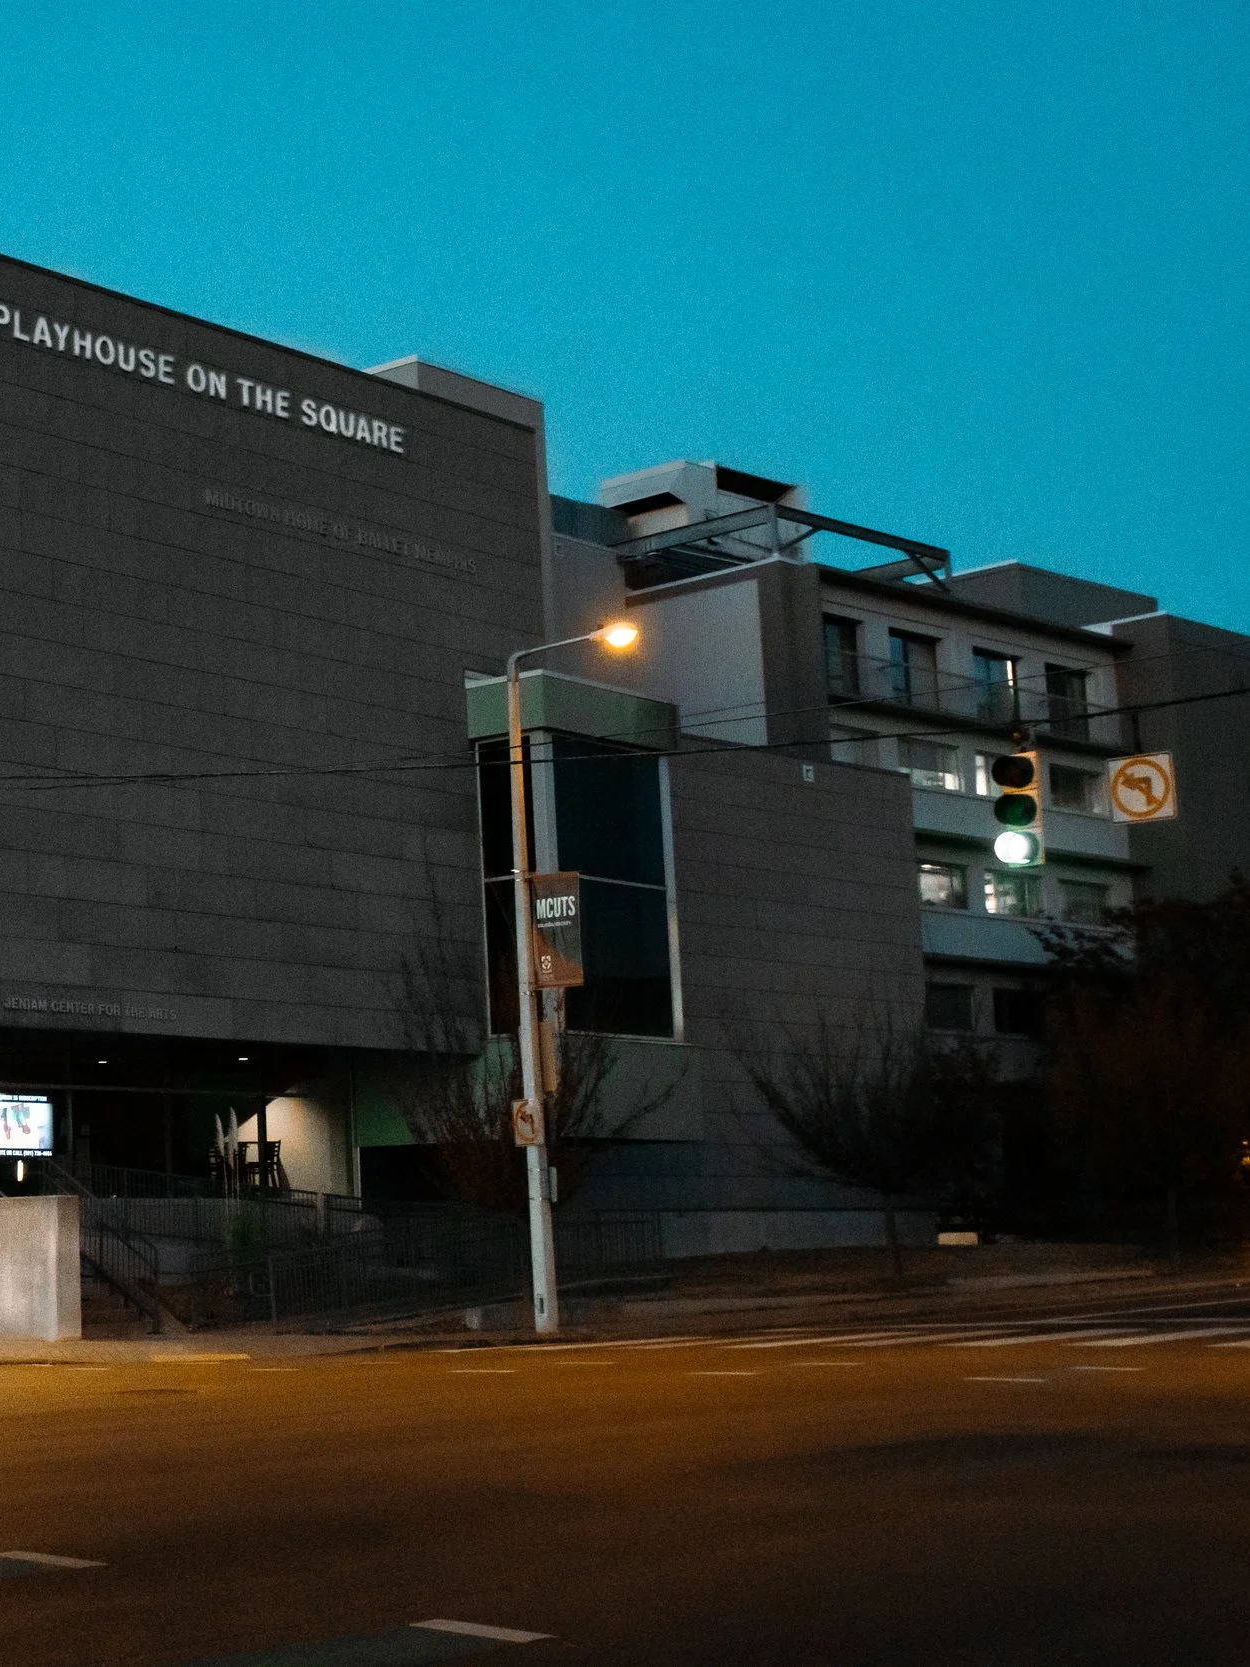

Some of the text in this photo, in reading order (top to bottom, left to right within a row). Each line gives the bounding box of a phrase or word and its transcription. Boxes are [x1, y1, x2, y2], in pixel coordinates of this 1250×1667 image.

[186, 362, 227, 400] ON
[237, 378, 290, 419] THE
[301, 399, 406, 454] SQUARE
[204, 488, 281, 521] MIDTOWN
[284, 509, 331, 536] HOME
[536, 895, 576, 920] MCUTS
[3, 997, 178, 1020] JENIAM CENTER FOR THE ARTS
